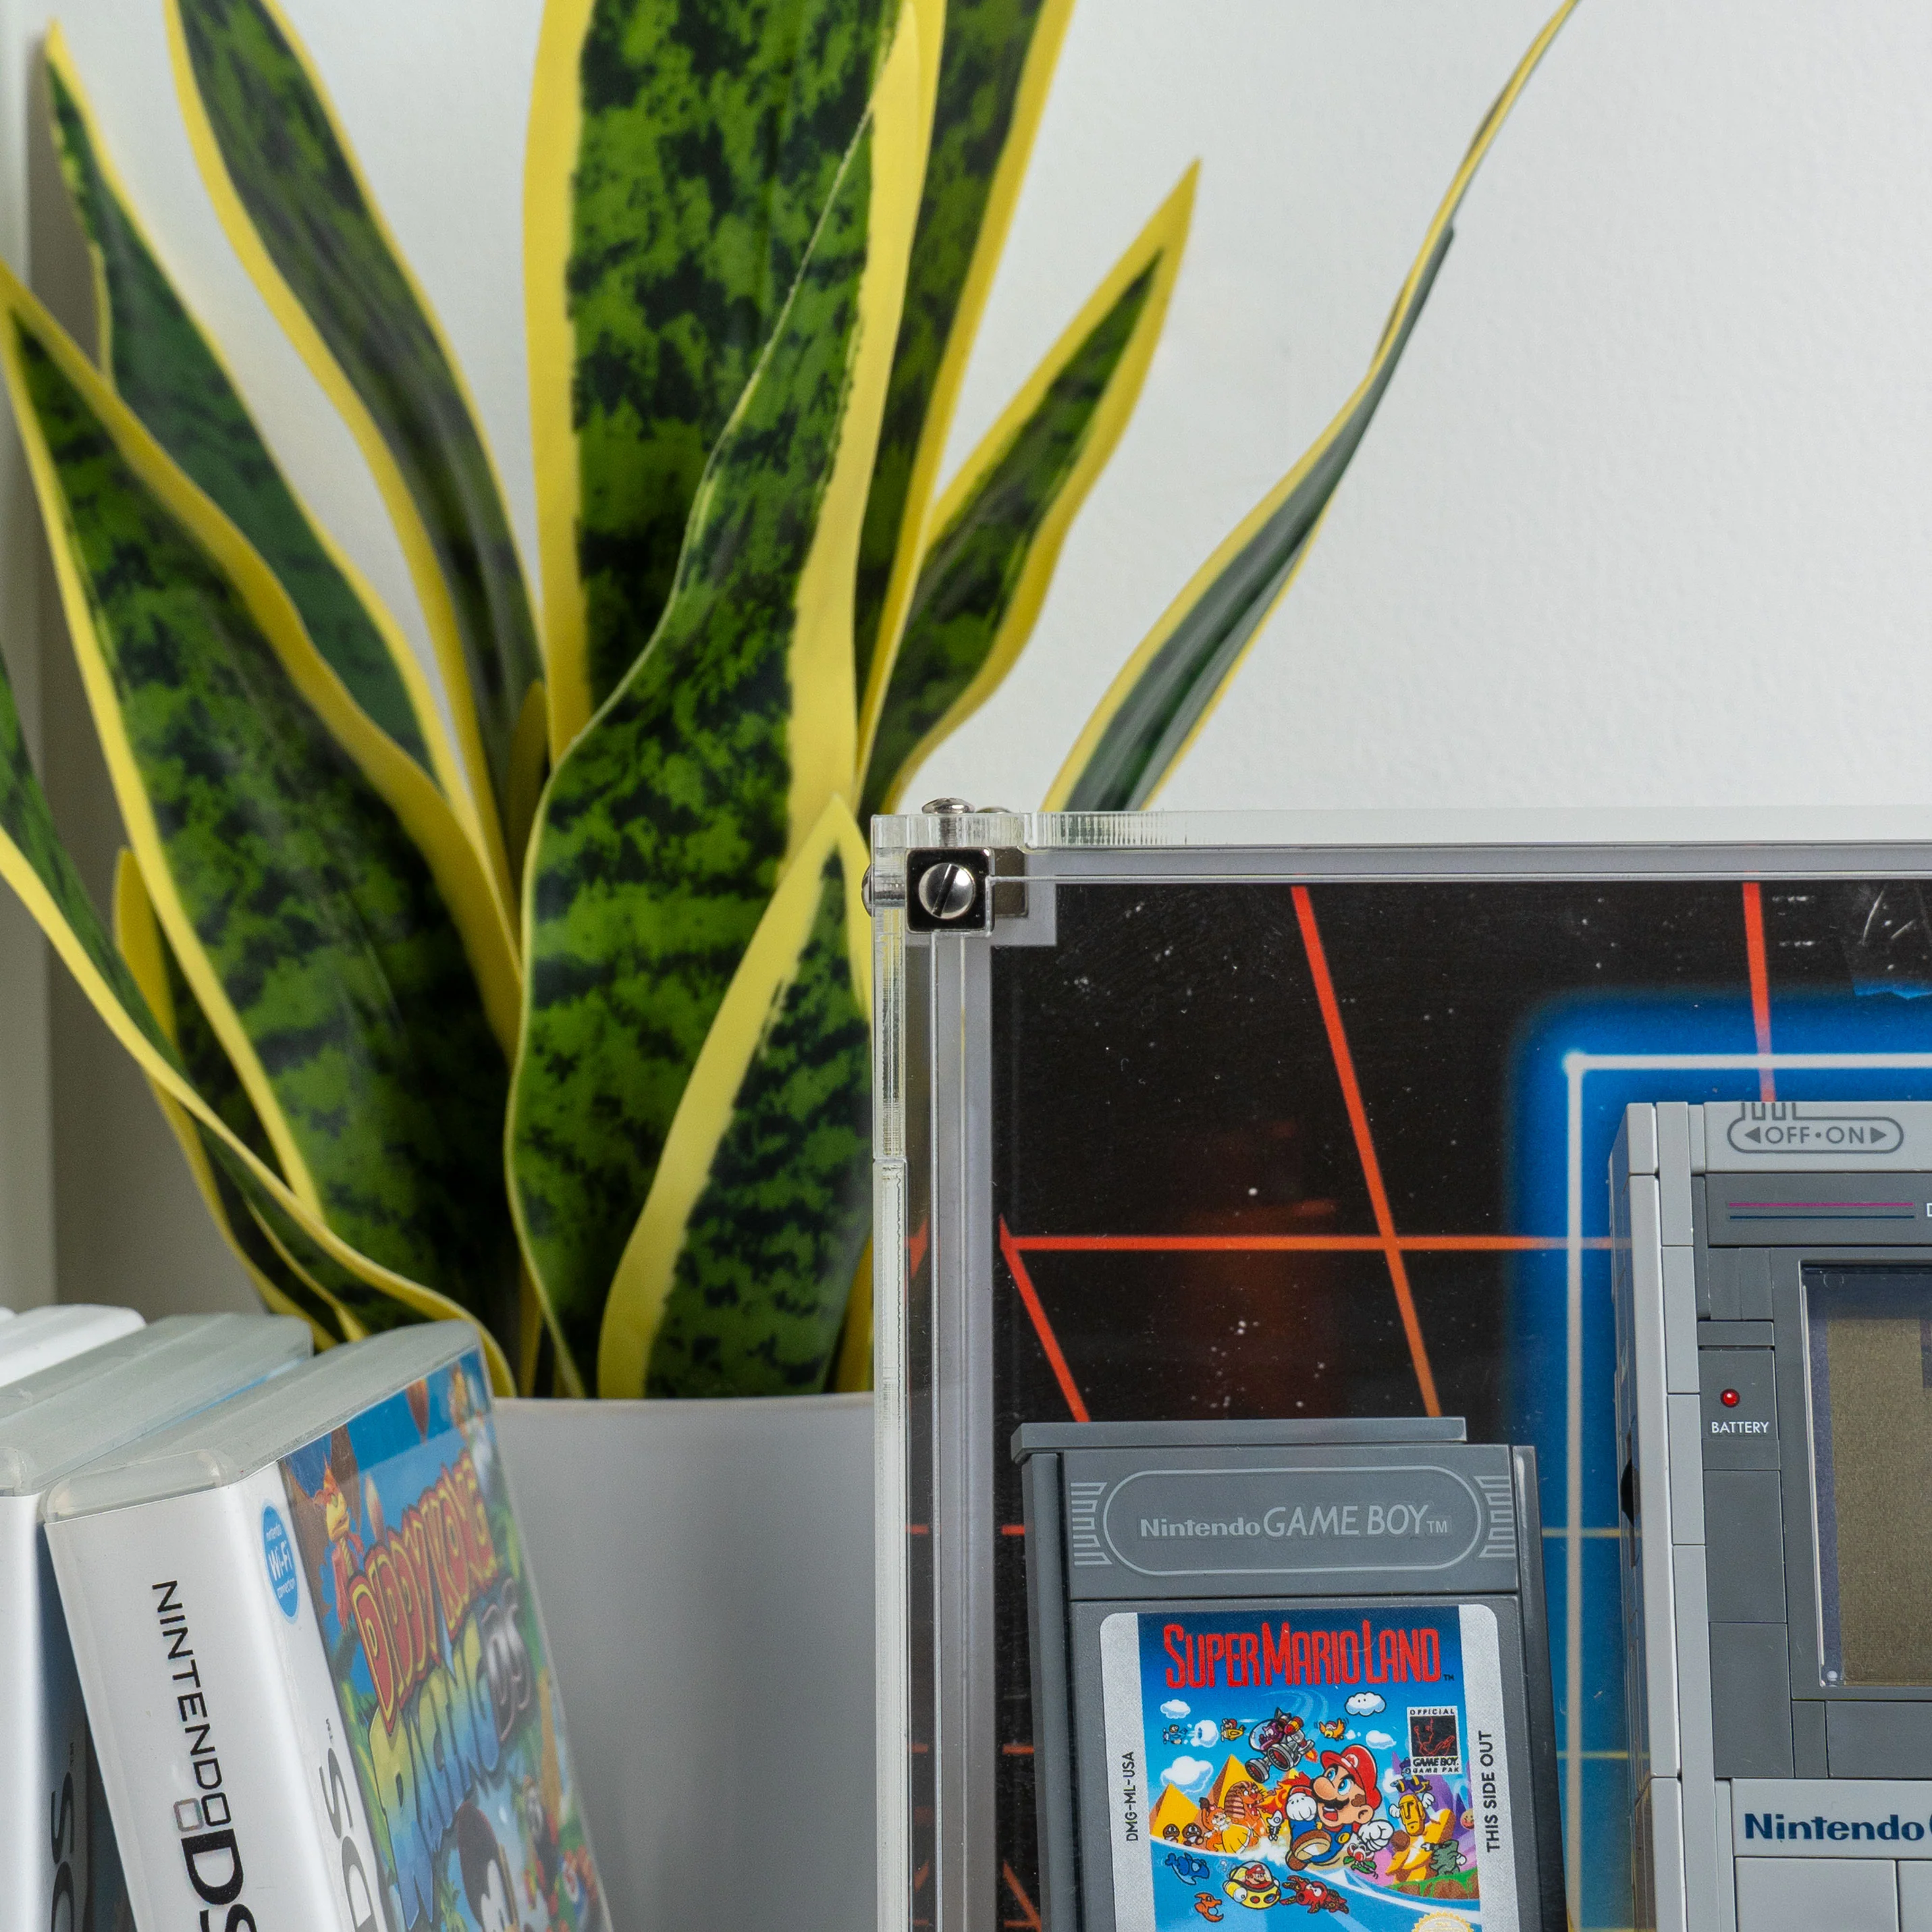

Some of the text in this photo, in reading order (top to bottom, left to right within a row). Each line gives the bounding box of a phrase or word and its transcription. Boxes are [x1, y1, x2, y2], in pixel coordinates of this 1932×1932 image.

[1765, 1126, 1864, 1144] OFF ON
[1711, 1421, 1769, 1433] BATTERY
[1140, 1517, 1260, 1536] Nintendo
[1263, 1505, 1359, 1537] GAME
[1367, 1504, 1428, 1536] BOY
[348, 1448, 498, 1734] DIDDY KONG
[1163, 1623, 1260, 1688] SUPER
[1261, 1621, 1360, 1686] MARIO
[1362, 1619, 1441, 1684] LAND
[152, 1580, 232, 1827] NINTENDO
[369, 1615, 500, 1930] RACING
[1413, 1757, 1440, 1767] GAME
[1478, 1730, 1500, 1852] THIS SIDE OUT
[1121, 1752, 1138, 1842] DMG-ML-USA
[1744, 1813, 1925, 1841] Nintendo
